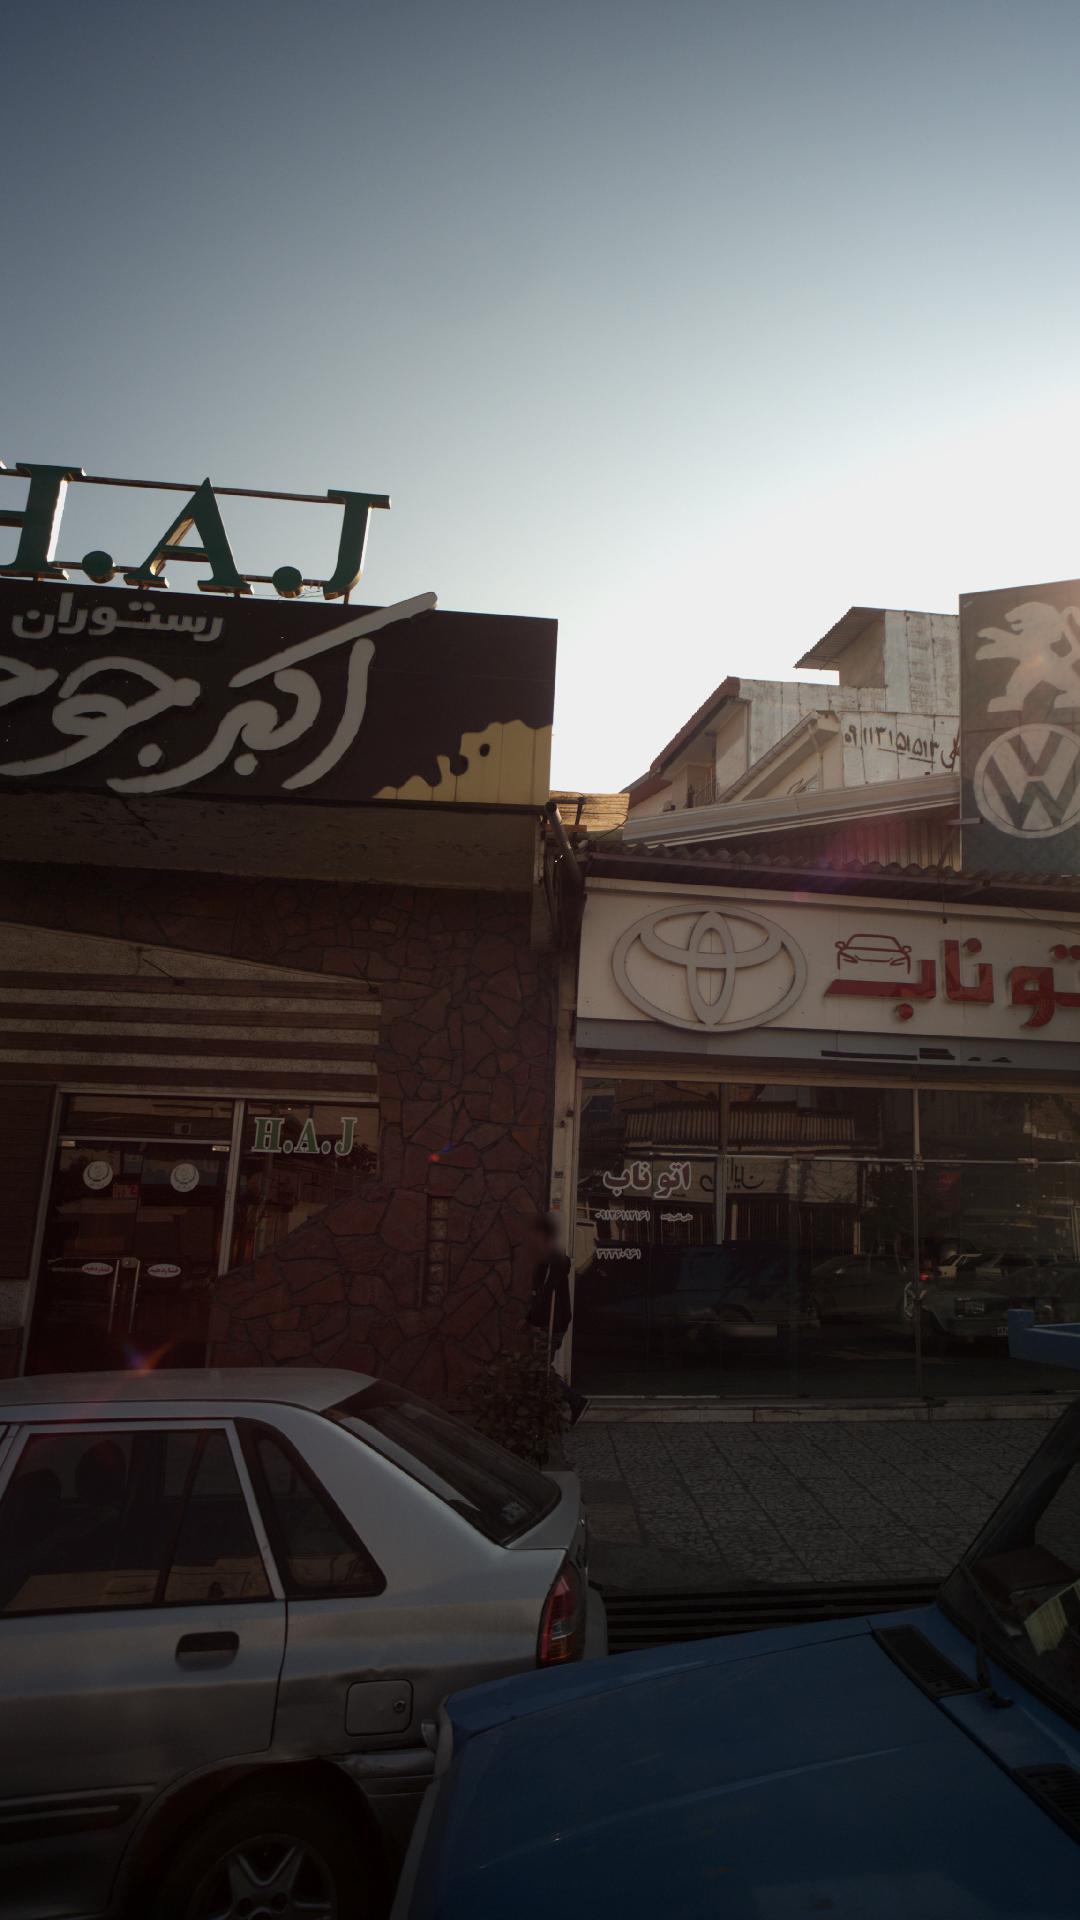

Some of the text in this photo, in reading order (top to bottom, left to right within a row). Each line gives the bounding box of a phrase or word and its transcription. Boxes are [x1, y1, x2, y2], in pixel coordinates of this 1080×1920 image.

[11, 592, 224, 642] رستوران
[106, 592, 437, 793] اکبر
[824, 937, 1080, 1028] تو ناب
[251, 1116, 358, 1157] H.A.J
[602, 1161, 652, 1197] ناب
[654, 1161, 692, 1199] اتو
